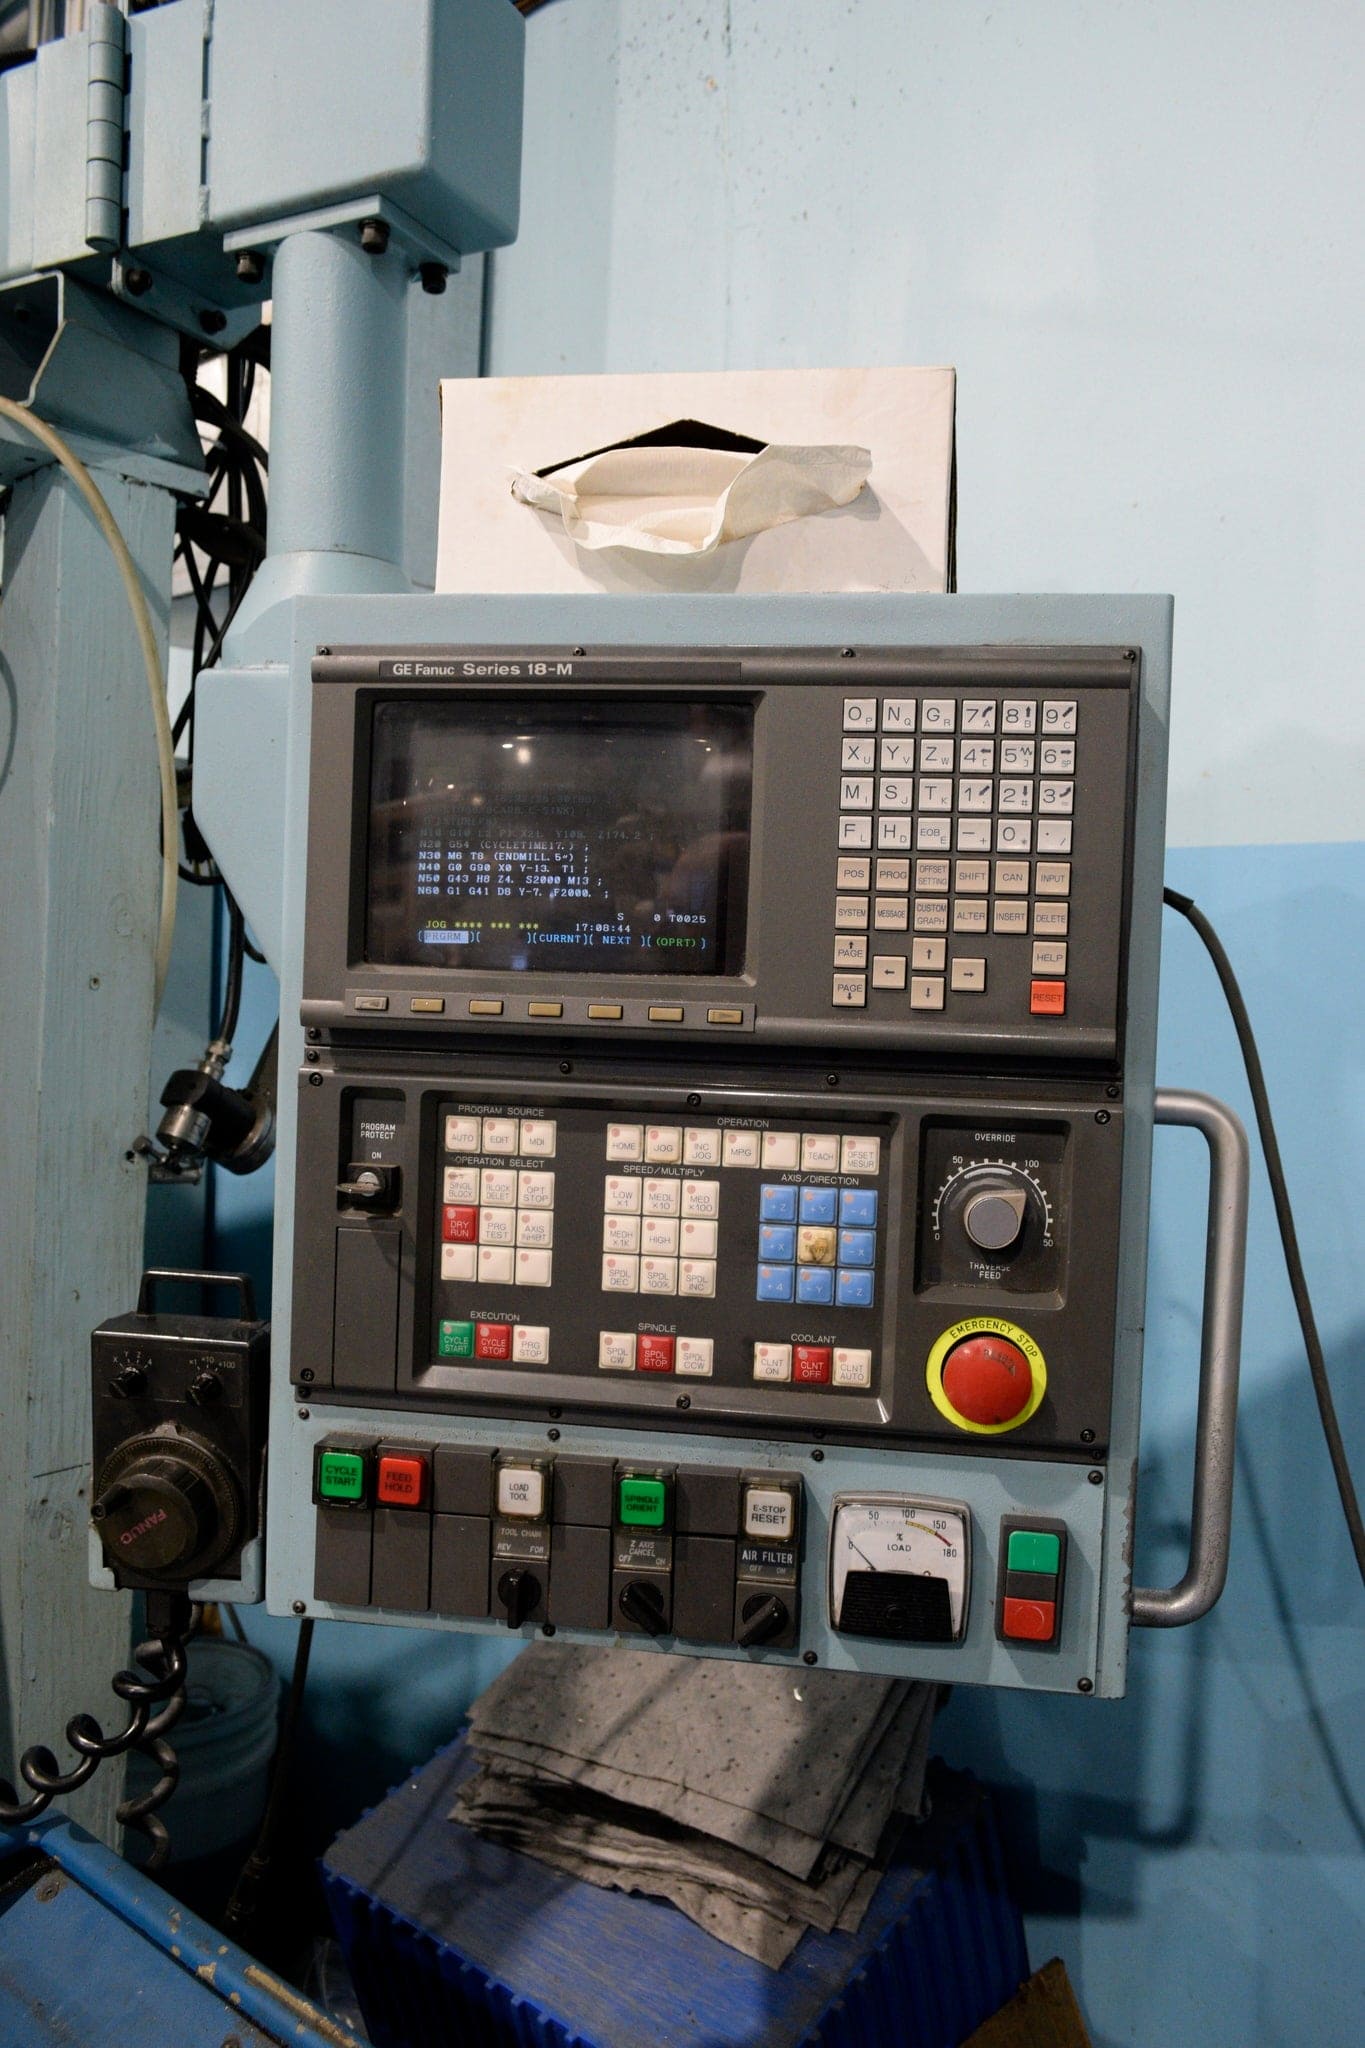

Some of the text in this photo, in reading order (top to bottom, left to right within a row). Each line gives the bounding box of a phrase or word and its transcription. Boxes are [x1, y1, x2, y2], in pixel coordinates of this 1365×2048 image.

[393, 663, 572, 675] GE Fanuc Series 18-M
[888, 707, 900, 721] N
[926, 707, 940, 722] G
[966, 708, 979, 723] 7
[1006, 708, 1019, 724] 8
[1046, 709, 1058, 724] 9
[847, 746, 860, 760] X
[886, 746, 899, 760] Y
[925, 747, 937, 761] Z
[964, 748, 976, 763] 4
[1004, 748, 1017, 763] 5
[1044, 749, 1057, 764] 6
[845, 785, 860, 799] M
[885, 785, 897, 799] S
[925, 786, 937, 800] T
[964, 787, 972, 801] 1
[1003, 788, 1016, 803] 2
[1043, 788, 1056, 803] 3
[844, 824, 856, 838] F
[884, 824, 896, 839] H
[920, 828, 940, 837] EOB
[418, 852, 484, 860] N30 M6 T8
[418, 863, 441, 871] N40
[919, 865, 946, 873] OFFSET
[844, 870, 864, 878] POS
[879, 871, 907, 879] PROG
[959, 872, 985, 881] SHIFT
[1002, 873, 1023, 881] CAN
[1041, 874, 1064, 883] INPUT
[417, 874, 589, 885] N50 G43 H8 S2000 M13
[918, 877, 947, 886] SETTING
[417, 886, 440, 895] N60
[447, 887, 460, 895] G1
[469, 887, 489, 895] G41
[497, 888, 511, 896] D8
[838, 908, 866, 917] SYSTEM
[917, 904, 947, 913] CUSTOM
[670, 914, 706, 924] T0025
[877, 910, 905, 919] MESSAGE
[956, 912, 985, 921] ALTER
[996, 912, 1025, 921] INSERT
[1036, 914, 1066, 924] DELETE
[425, 920, 447, 929] JOG
[917, 917, 945, 926] GRAPH
[575, 923, 631, 932] 17:08:44
[838, 949, 863, 958] PAGE
[1036, 953, 1063, 962] HELP
[838, 984, 863, 992] PAGE
[1033, 993, 1062, 1002] RESET
[458, 1105, 545, 1116] PROGRAM SOURCE
[360, 1122, 396, 1131] PROGRAM
[717, 1118, 770, 1128] OPERATION
[360, 1131, 395, 1139] PROTECT
[975, 1133, 1017, 1143] OVERRIDE
[490, 1136, 509, 1144] EDIT
[529, 1138, 545, 1146] MDI
[612, 1142, 636, 1150] HOME
[653, 1144, 673, 1152] JOG
[694, 1143, 709, 1151] INC
[691, 1151, 712, 1159] JOG
[731, 1148, 752, 1157] MPG
[808, 1152, 834, 1160] TEACH
[455, 1156, 545, 1169] OPERATION SELECT
[952, 1156, 963, 1164] 50
[1025, 1160, 1039, 1168] 100
[623, 1165, 705, 1177] SPEED/MULTIPLY
[526, 1186, 545, 1194] OPT
[523, 1194, 549, 1202] STOP
[612, 1191, 633, 1199] LOW
[690, 1195, 710, 1203] MED
[450, 1221, 469, 1229] DRY
[487, 1223, 507, 1231] PRG
[525, 1225, 545, 1233] AXIS
[450, 1229, 469, 1237] RUN
[486, 1231, 508, 1239] TEST
[649, 1235, 671, 1244] HIGH
[979, 1271, 1001, 1279] FEED
[610, 1278, 629, 1286] DEC
[470, 1311, 520, 1321] EXECUTION
[638, 1323, 677, 1333] SPINDLE
[444, 1336, 469, 1345] CYCLE
[481, 1338, 505, 1346] CYCLE
[791, 1334, 836, 1344] COOLANT
[950, 1320, 1038, 1357] EMERGENCY STOP
[444, 1344, 468, 1352] START
[483, 1346, 505, 1355] STOP
[520, 1349, 542, 1357] STOP
[643, 1351, 664, 1359] SPDL
[644, 1358, 667, 1367] STOP
[761, 1359, 784, 1367] CLNT
[800, 1362, 823, 1370] CLNT
[765, 1367, 779, 1375] ON
[840, 1364, 863, 1373] CLNT
[802, 1370, 821, 1378] OFF
[840, 1373, 864, 1381] AUTO
[325, 1466, 357, 1476] CYCLE
[325, 1476, 357, 1487] START
[387, 1472, 413, 1483] FEED
[385, 1483, 413, 1494] HOLD
[509, 1483, 529, 1492] LOAD
[510, 1492, 528, 1501] TOOL
[753, 1504, 786, 1514] E-STOP
[868, 1511, 879, 1520] 50
[901, 1509, 915, 1519] 100
[751, 1514, 787, 1524] RESET
[120, 1508, 169, 1546] FANUC
[932, 1520, 946, 1530] 150
[501, 1528, 518, 1537] TOOL
[887, 1544, 911, 1552] LOAD
[742, 1550, 793, 1564] AIR FILTER
[943, 1548, 957, 1558] 180
[619, 1554, 632, 1563] OFF
